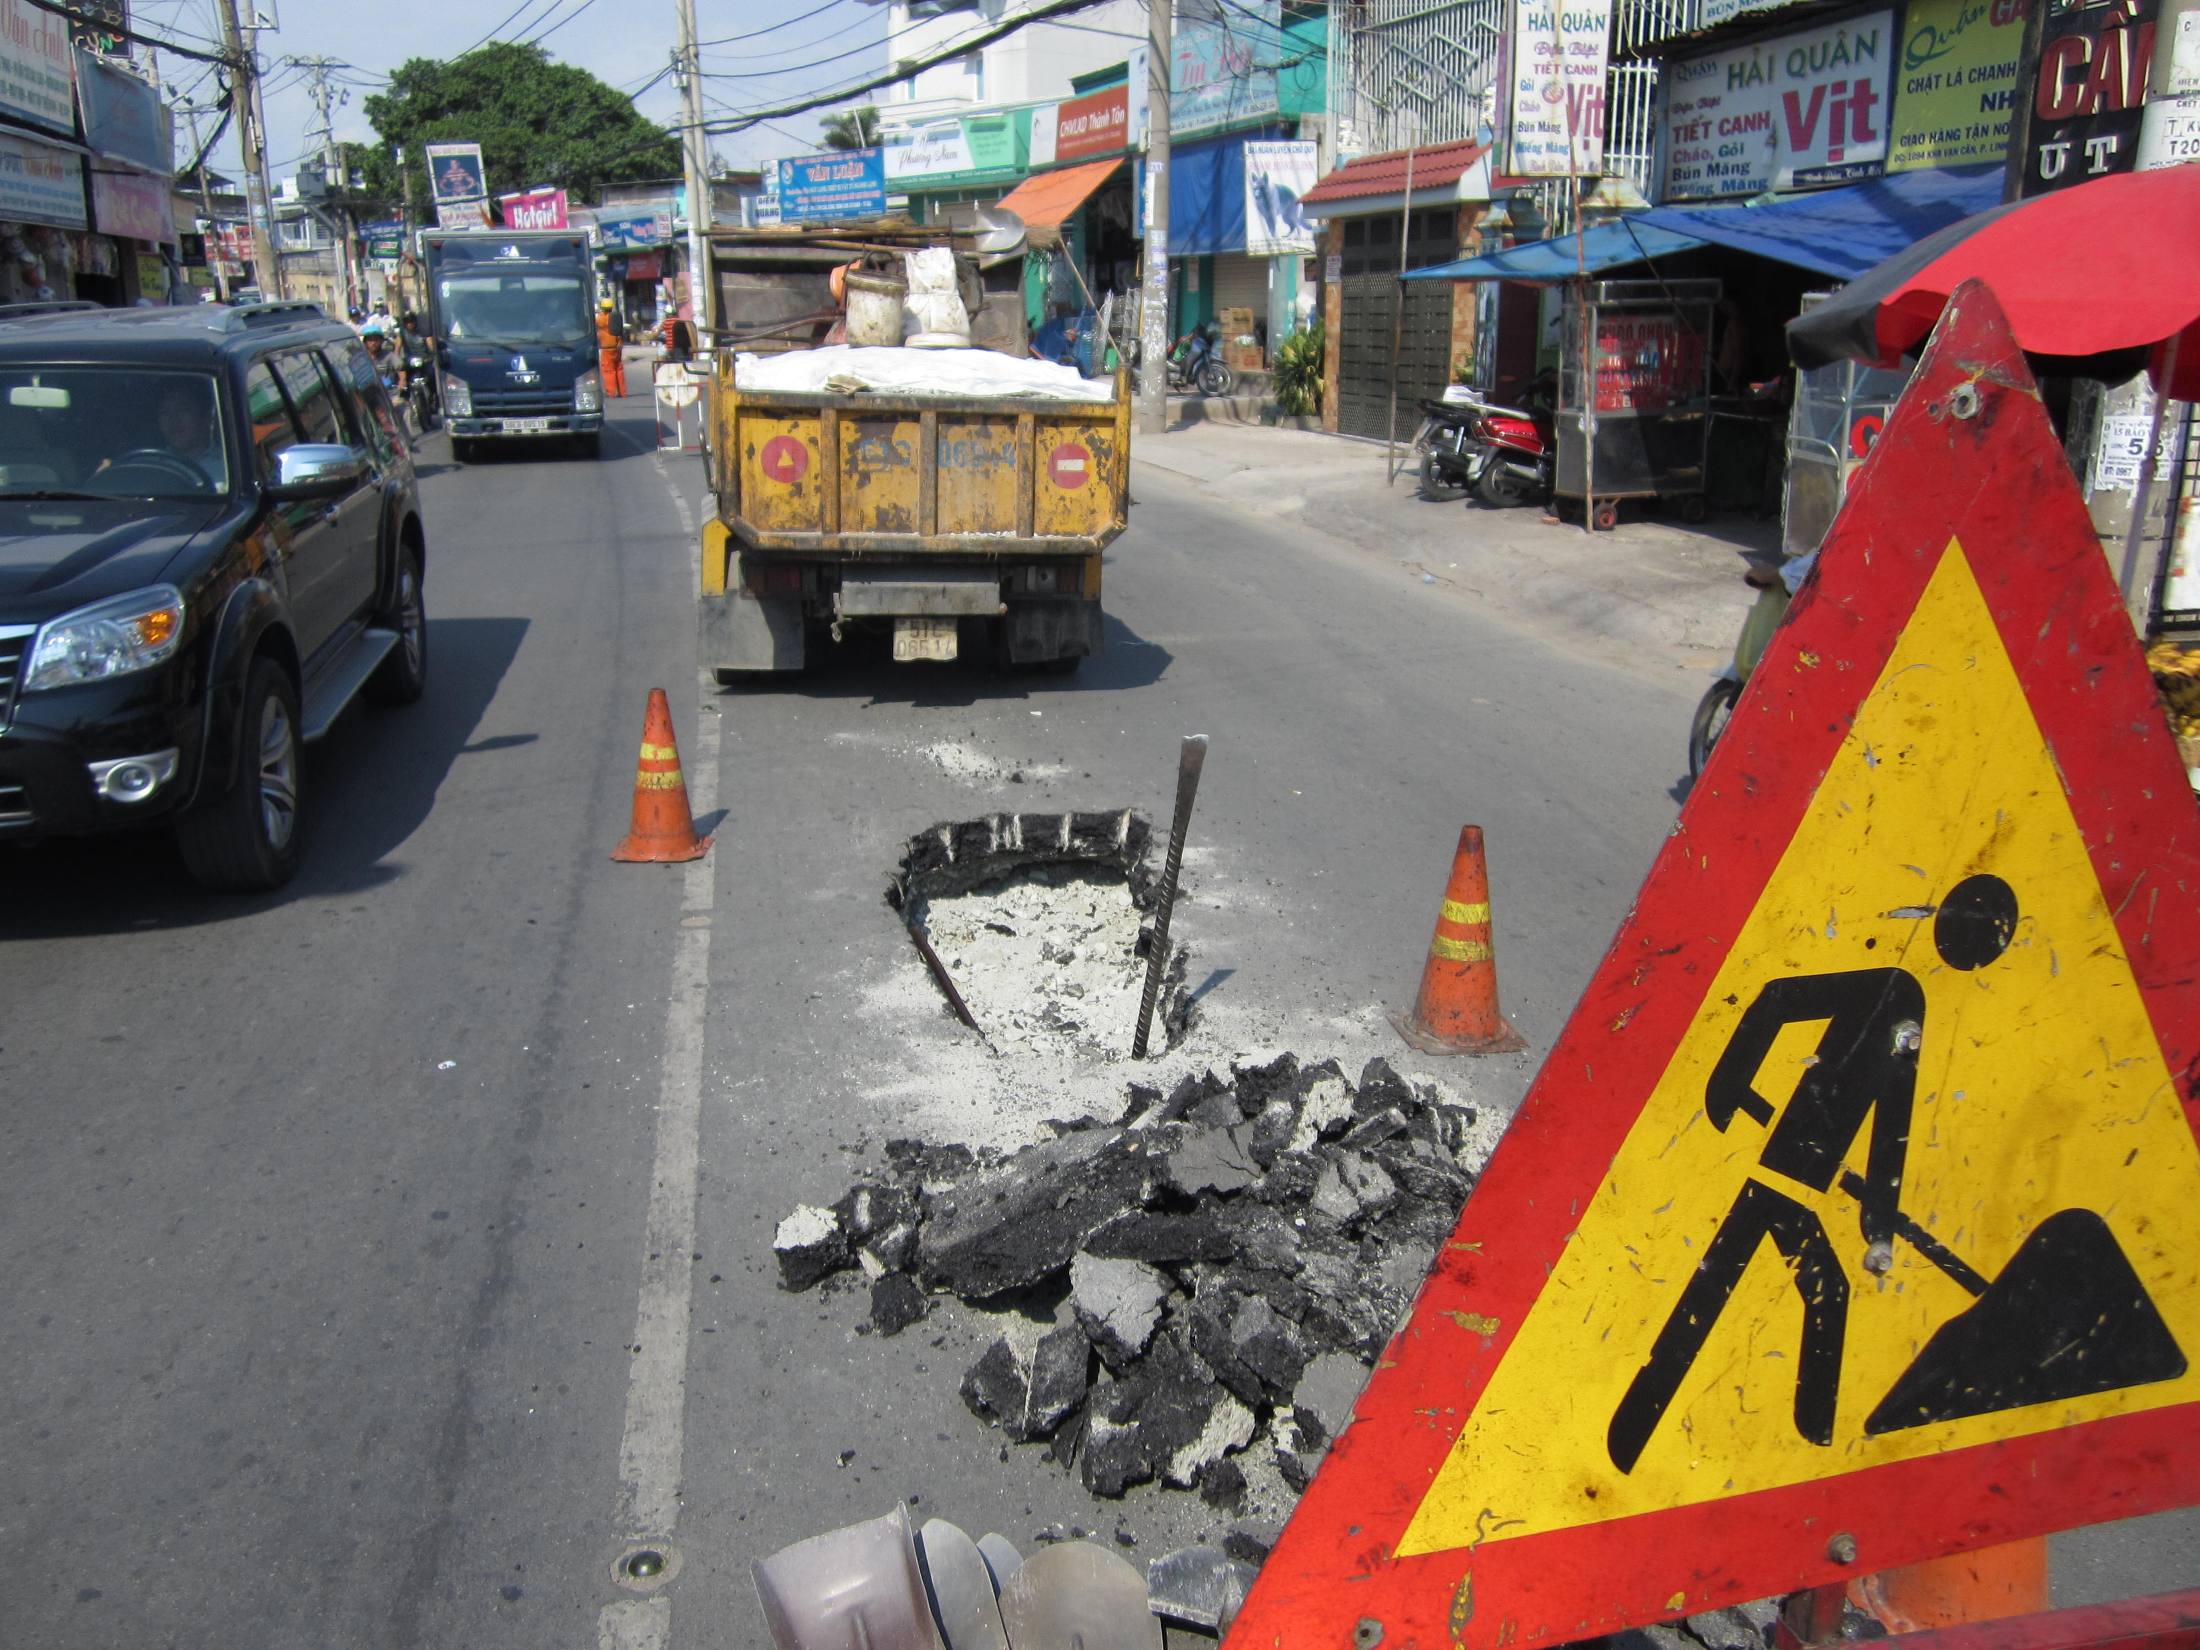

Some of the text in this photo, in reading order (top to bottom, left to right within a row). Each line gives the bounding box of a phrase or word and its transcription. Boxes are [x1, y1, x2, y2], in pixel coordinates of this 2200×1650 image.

[1561, 9, 1606, 33] QUÂN
[1565, 64, 1598, 75] CANH
[1727, 46, 1775, 92] HẢI
[1786, 29, 1879, 79] QUÂN
[1968, 61, 2018, 84] CHANH
[1565, 82, 1607, 151] Vịt
[1672, 110, 1771, 145] TIẾT CANH
[1782, 78, 1879, 163] Vịt
[1900, 132, 1926, 148] GIAO
